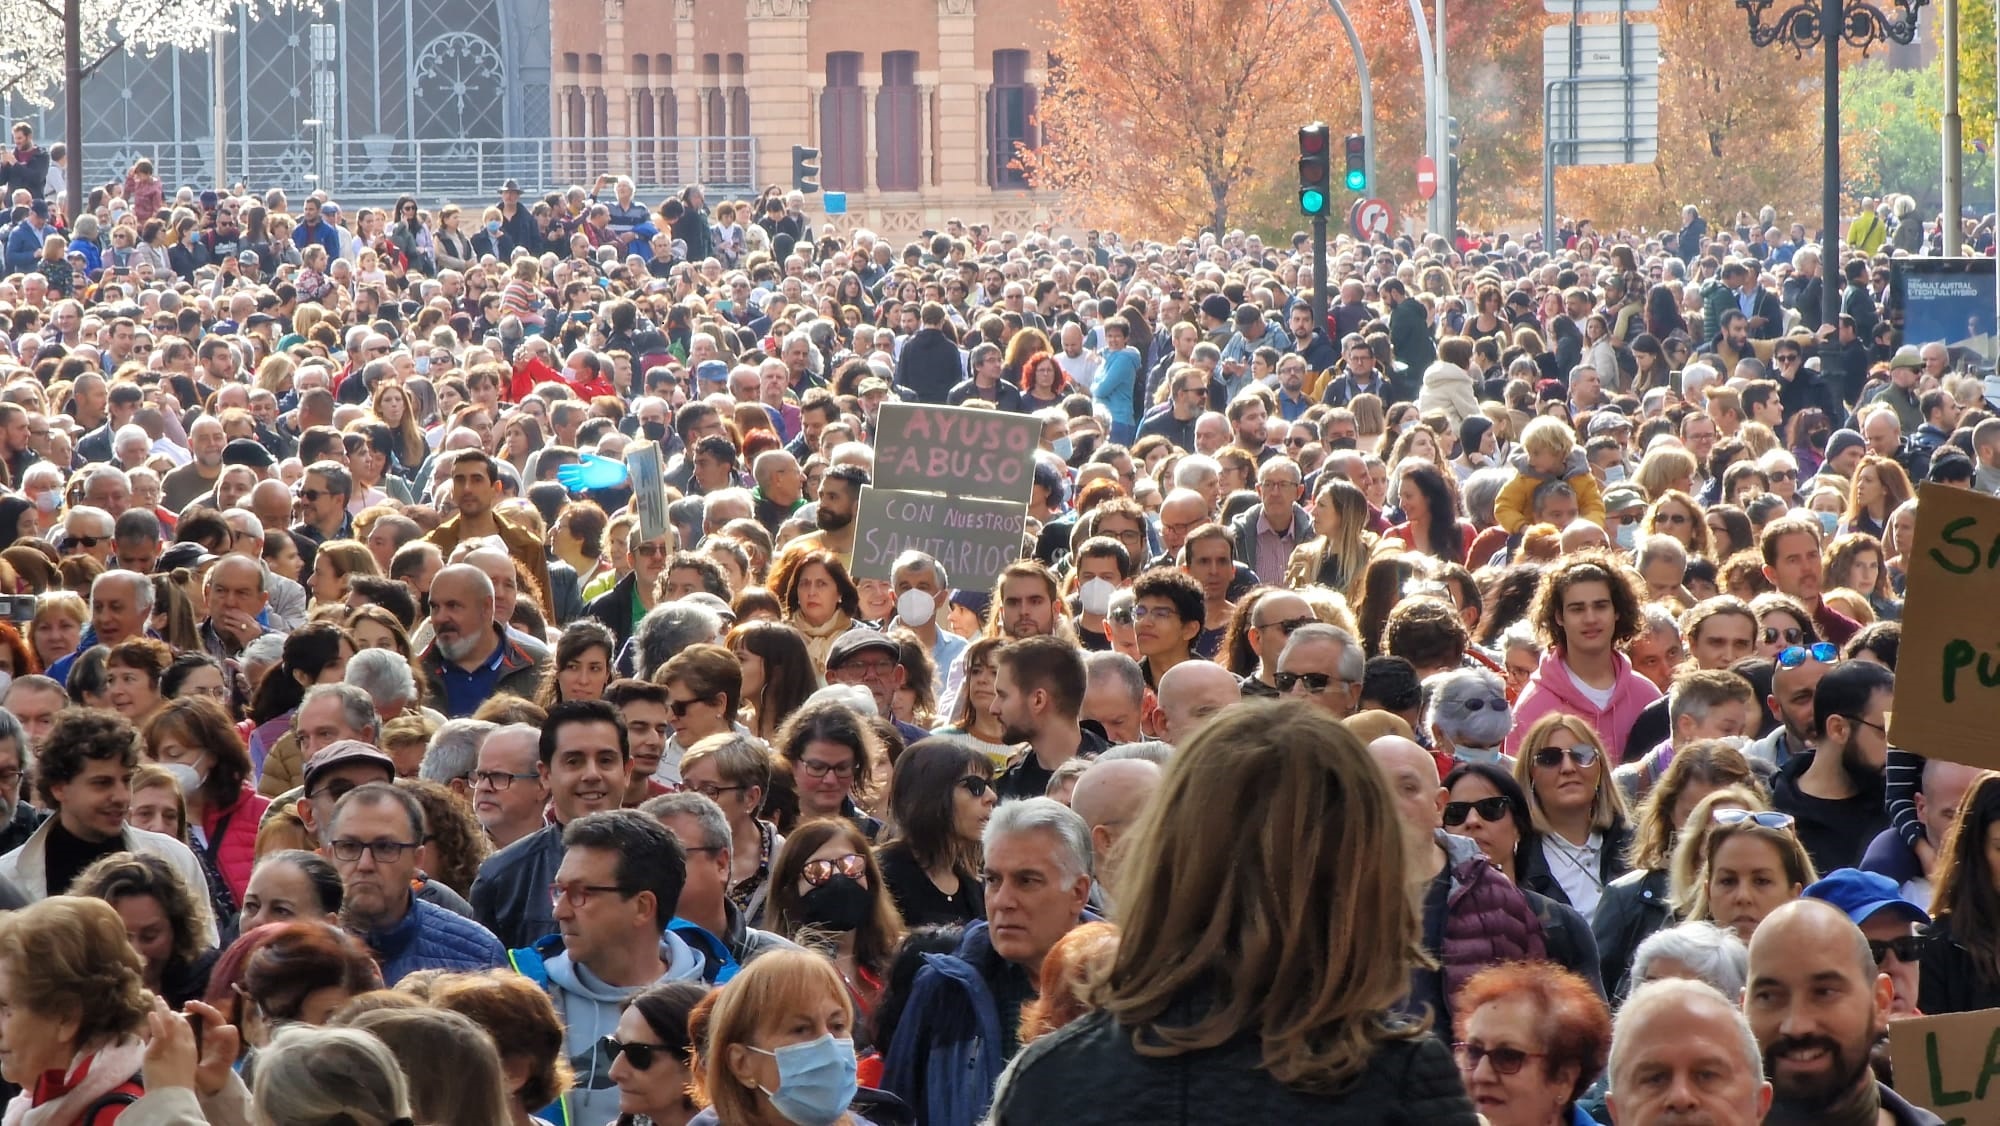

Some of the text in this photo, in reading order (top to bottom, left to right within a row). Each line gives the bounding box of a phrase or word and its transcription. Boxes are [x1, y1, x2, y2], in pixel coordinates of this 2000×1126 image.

[904, 409, 1028, 453] AYUSO
[886, 500, 1024, 534] CON NUESTROS
